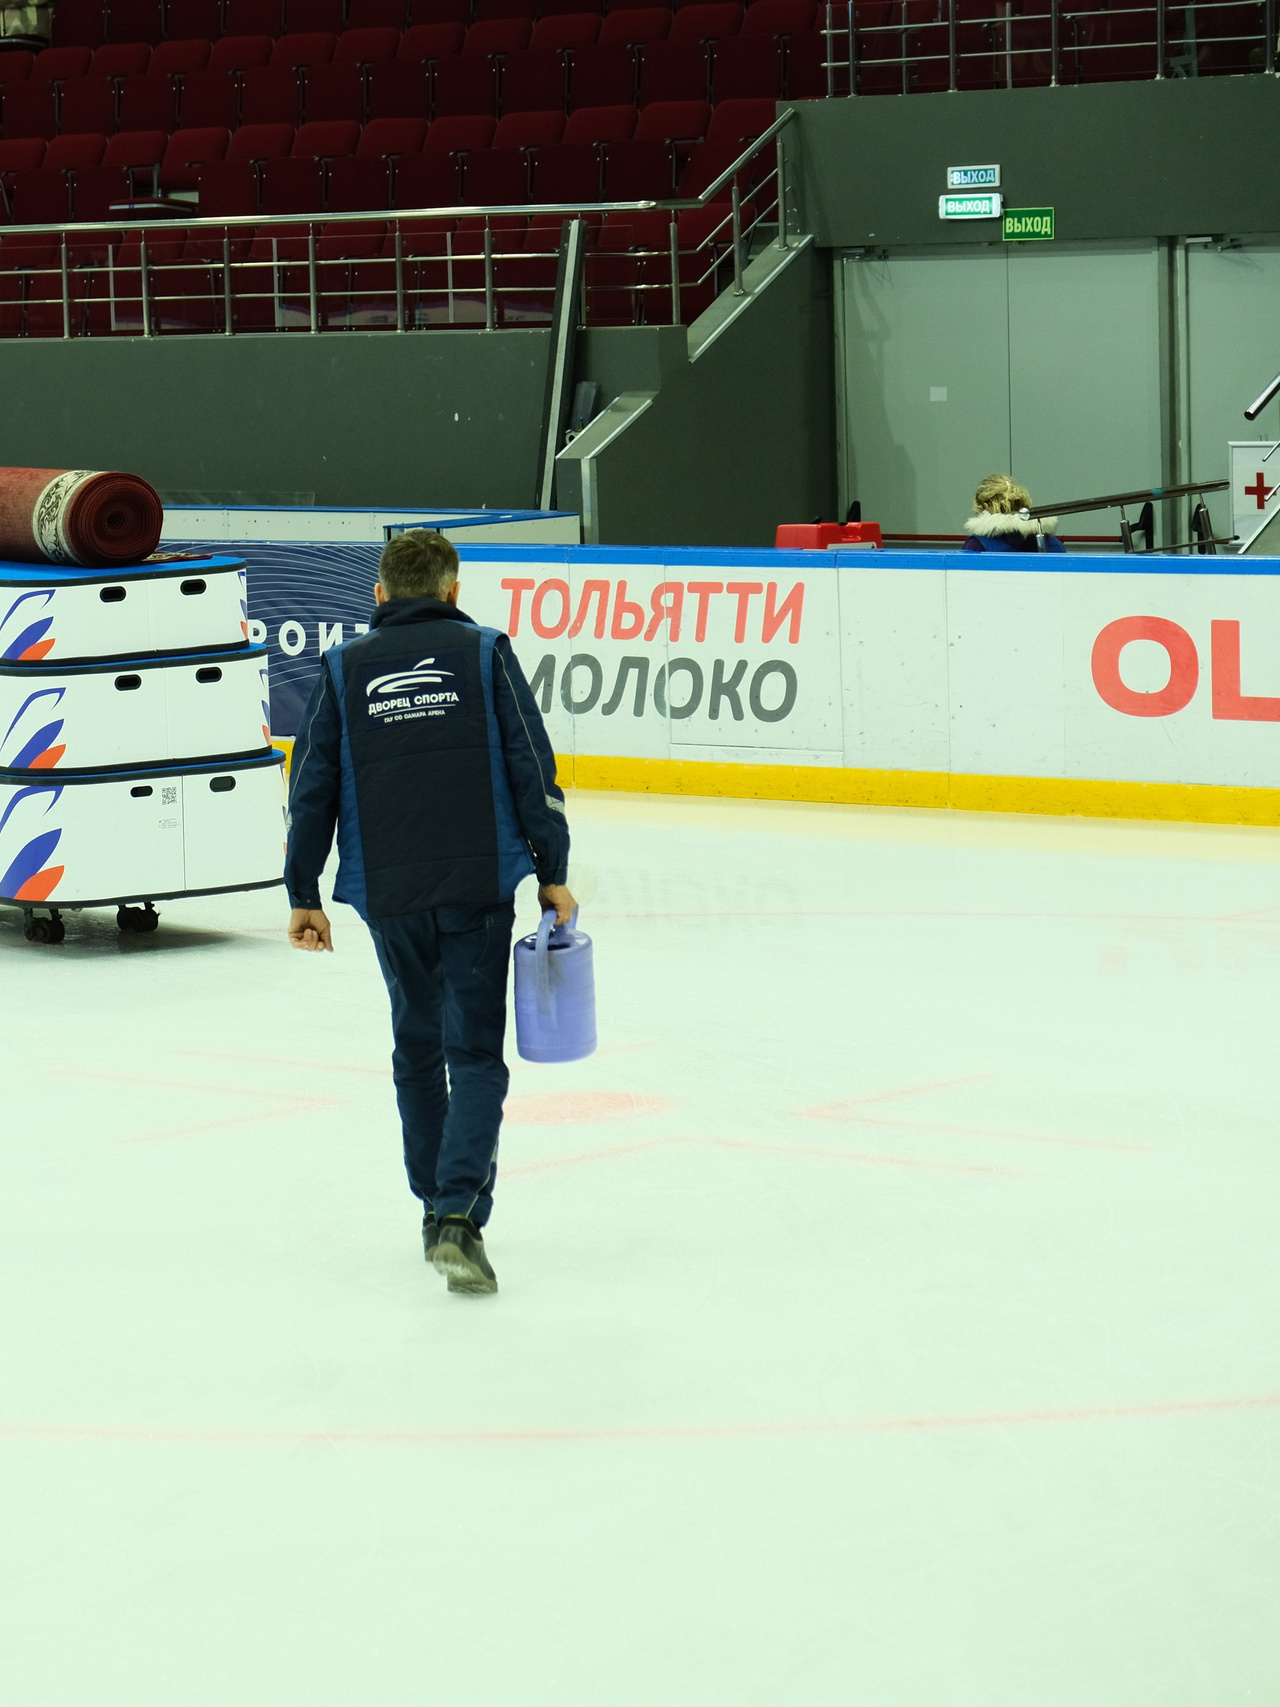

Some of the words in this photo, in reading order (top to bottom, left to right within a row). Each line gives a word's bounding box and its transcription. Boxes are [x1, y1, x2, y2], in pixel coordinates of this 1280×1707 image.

[952, 169, 995, 184] ВЫХОД
[947, 200, 990, 213] ВЫХОД
[1005, 216, 1051, 235] ВЫХОД
[501, 578, 805, 644] ТОЛЬЯТТИ
[368, 697, 411, 715] ДВОРЕЦ
[414, 692, 460, 705] СПОРТА
[404, 711, 426, 719] САМАРА
